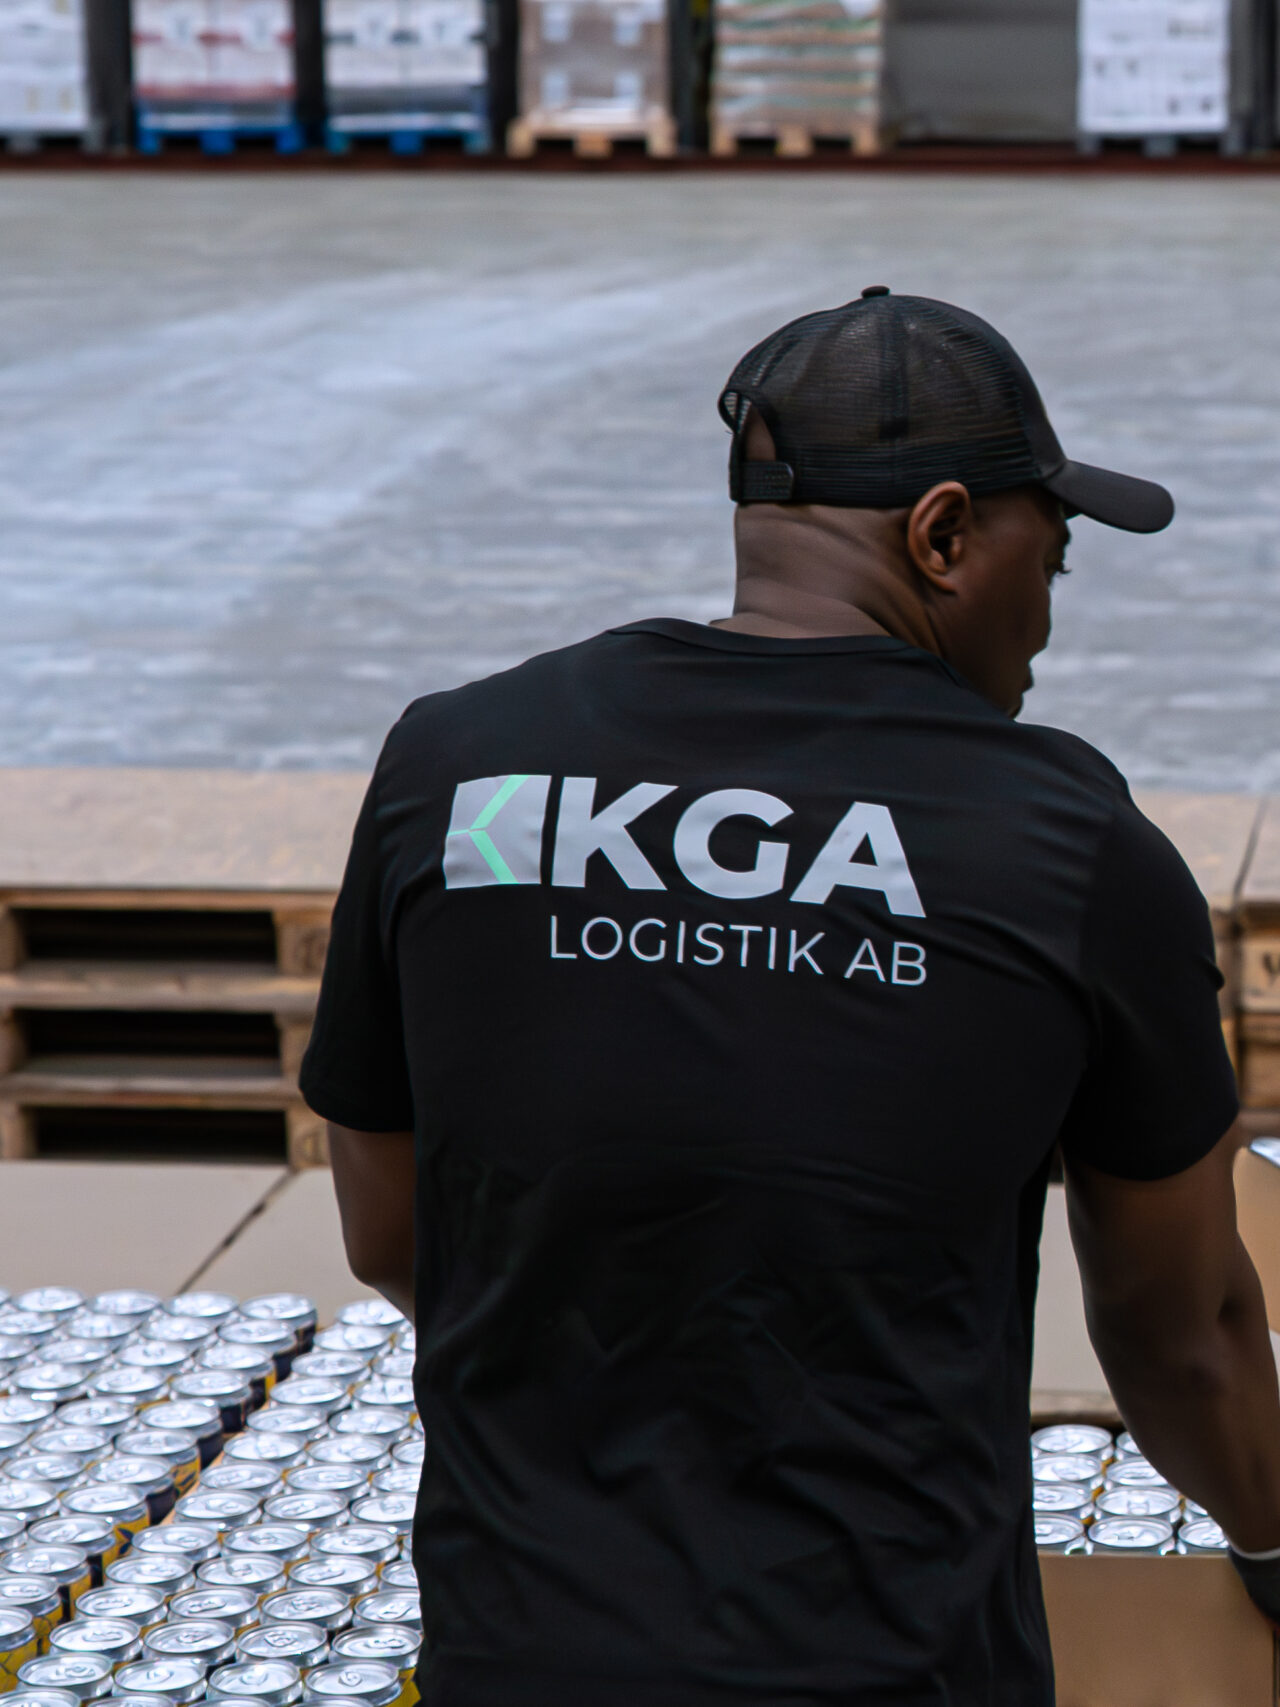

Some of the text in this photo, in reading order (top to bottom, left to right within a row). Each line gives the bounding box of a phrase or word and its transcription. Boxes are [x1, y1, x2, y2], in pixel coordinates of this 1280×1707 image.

[551, 776, 927, 919] KGA
[550, 915, 927, 986] LOGISTIK AB
